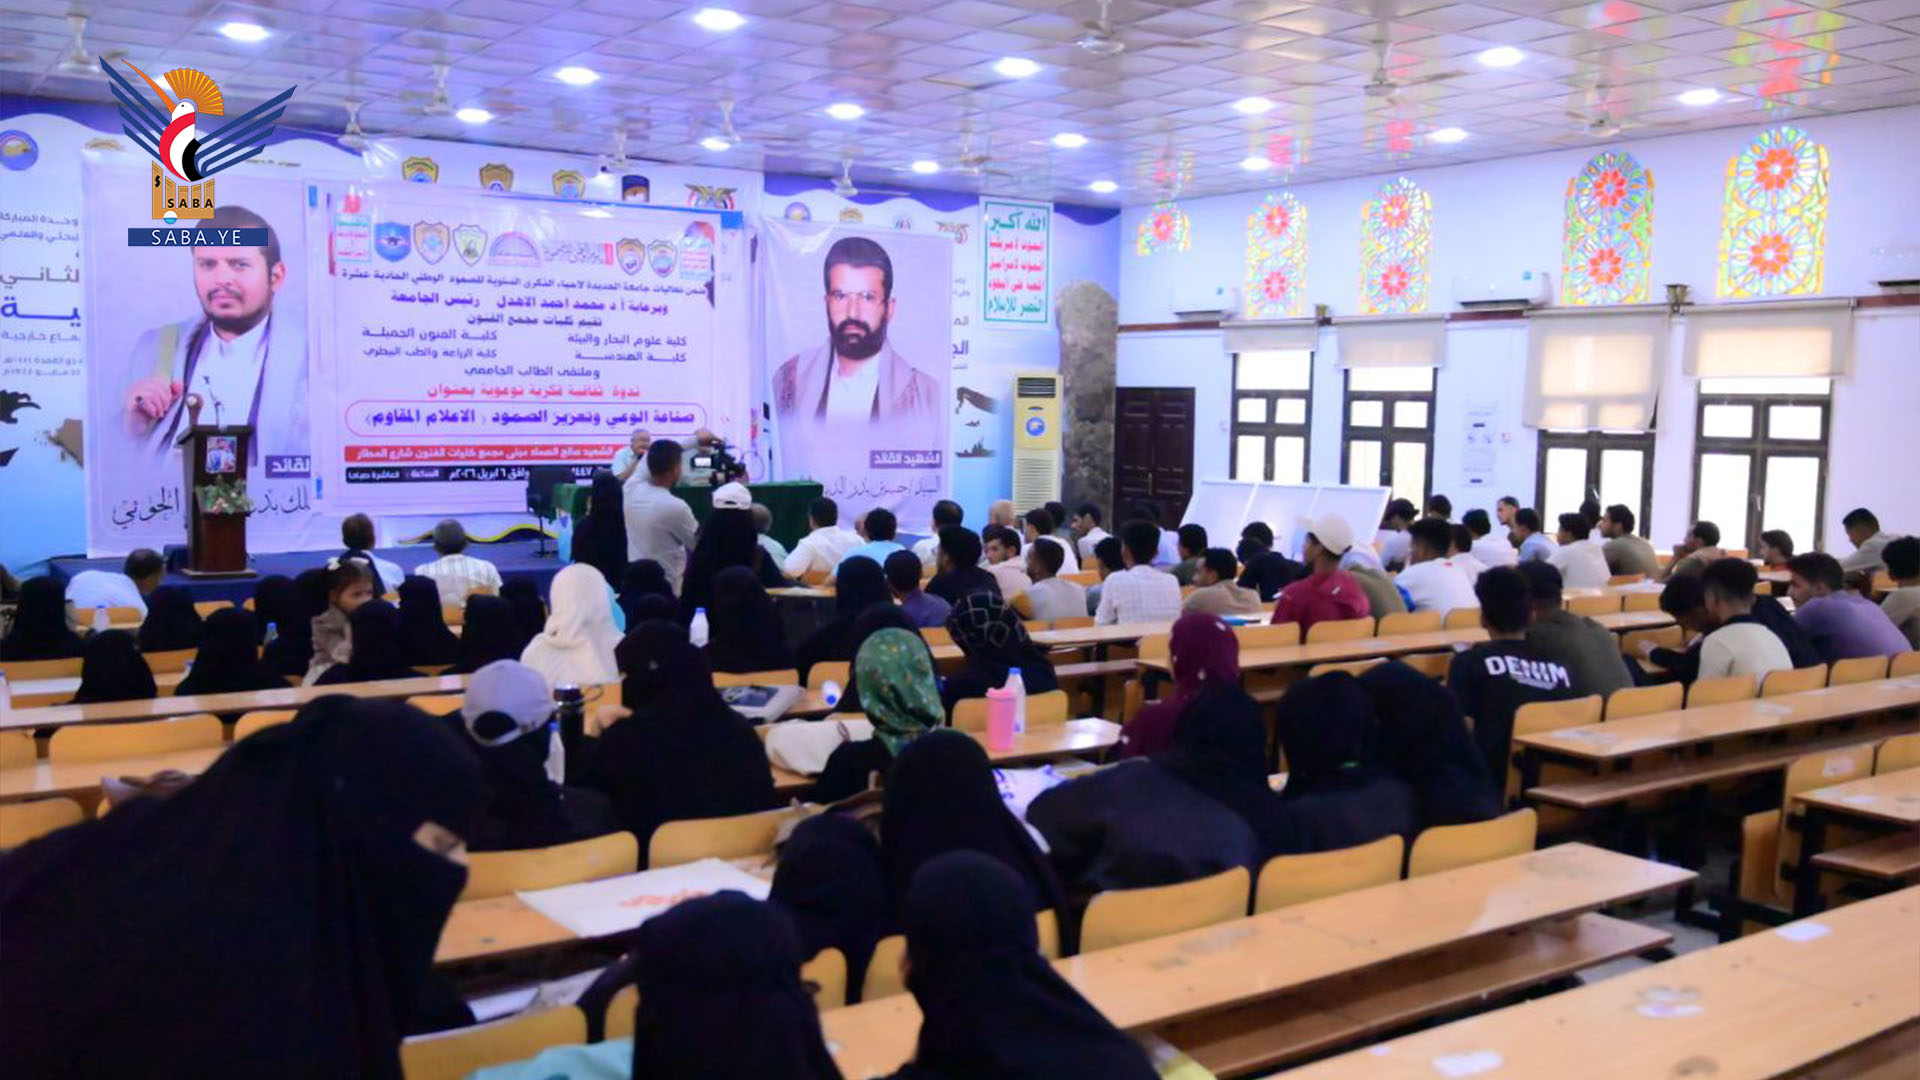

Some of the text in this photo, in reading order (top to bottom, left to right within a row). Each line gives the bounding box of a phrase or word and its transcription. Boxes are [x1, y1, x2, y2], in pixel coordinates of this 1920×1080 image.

[0, 265, 80, 289] لثاني
[342, 268, 370, 280] عشرة
[373, 271, 408, 281] الحادية
[412, 273, 444, 285] الوطني
[624, 282, 650, 293] جامعة
[391, 290, 440, 304] الجامعة
[444, 293, 481, 307] رئيس
[573, 300, 605, 311] محمد
[633, 336, 662, 348] علوم
[492, 408, 548, 425] الصمود
[552, 409, 601, 426] وتعزيز
[606, 410, 649, 428] الوعي
[653, 408, 695, 423] صناعة
[272, 457, 310, 473] لقائد
[112, 486, 181, 529] الحوثي
[1484, 654, 1571, 689] DENIM
